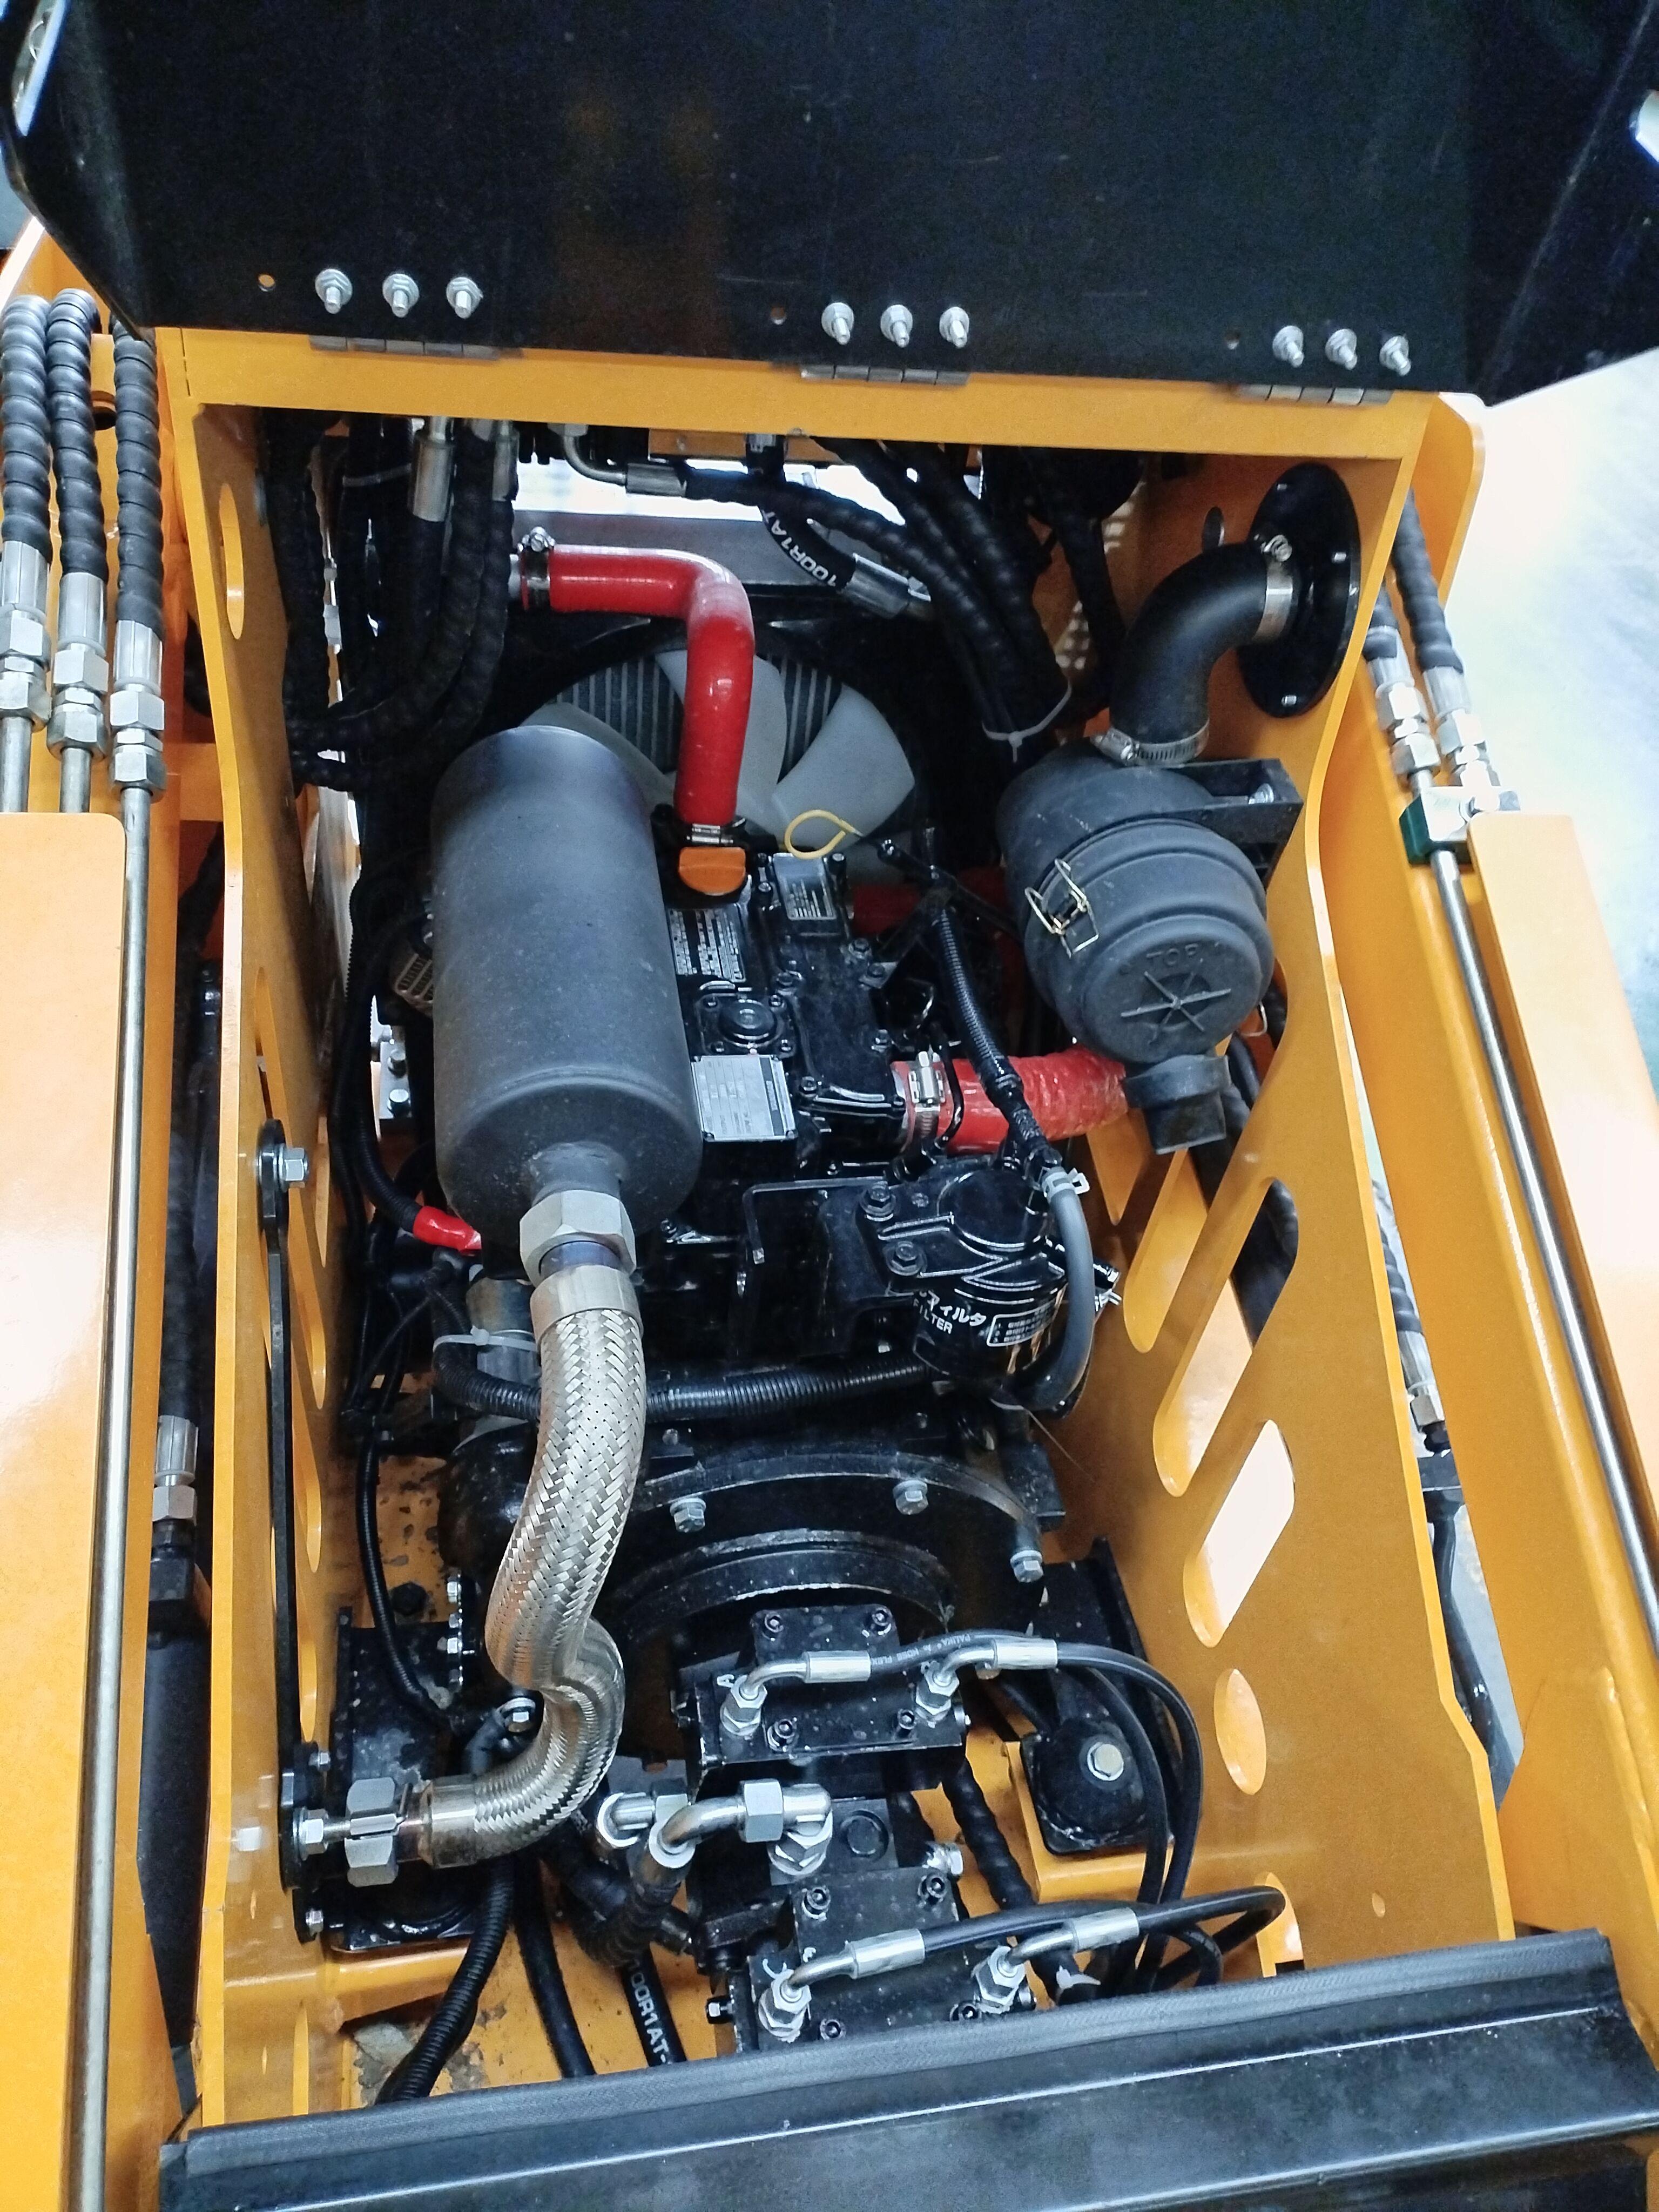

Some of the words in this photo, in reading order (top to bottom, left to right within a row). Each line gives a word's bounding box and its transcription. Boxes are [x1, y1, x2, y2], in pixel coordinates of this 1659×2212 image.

[1145, 943, 1199, 967] TOP
[913, 1298, 953, 1334] FILTER
[628, 1958, 673, 2065] 100R1AT-
